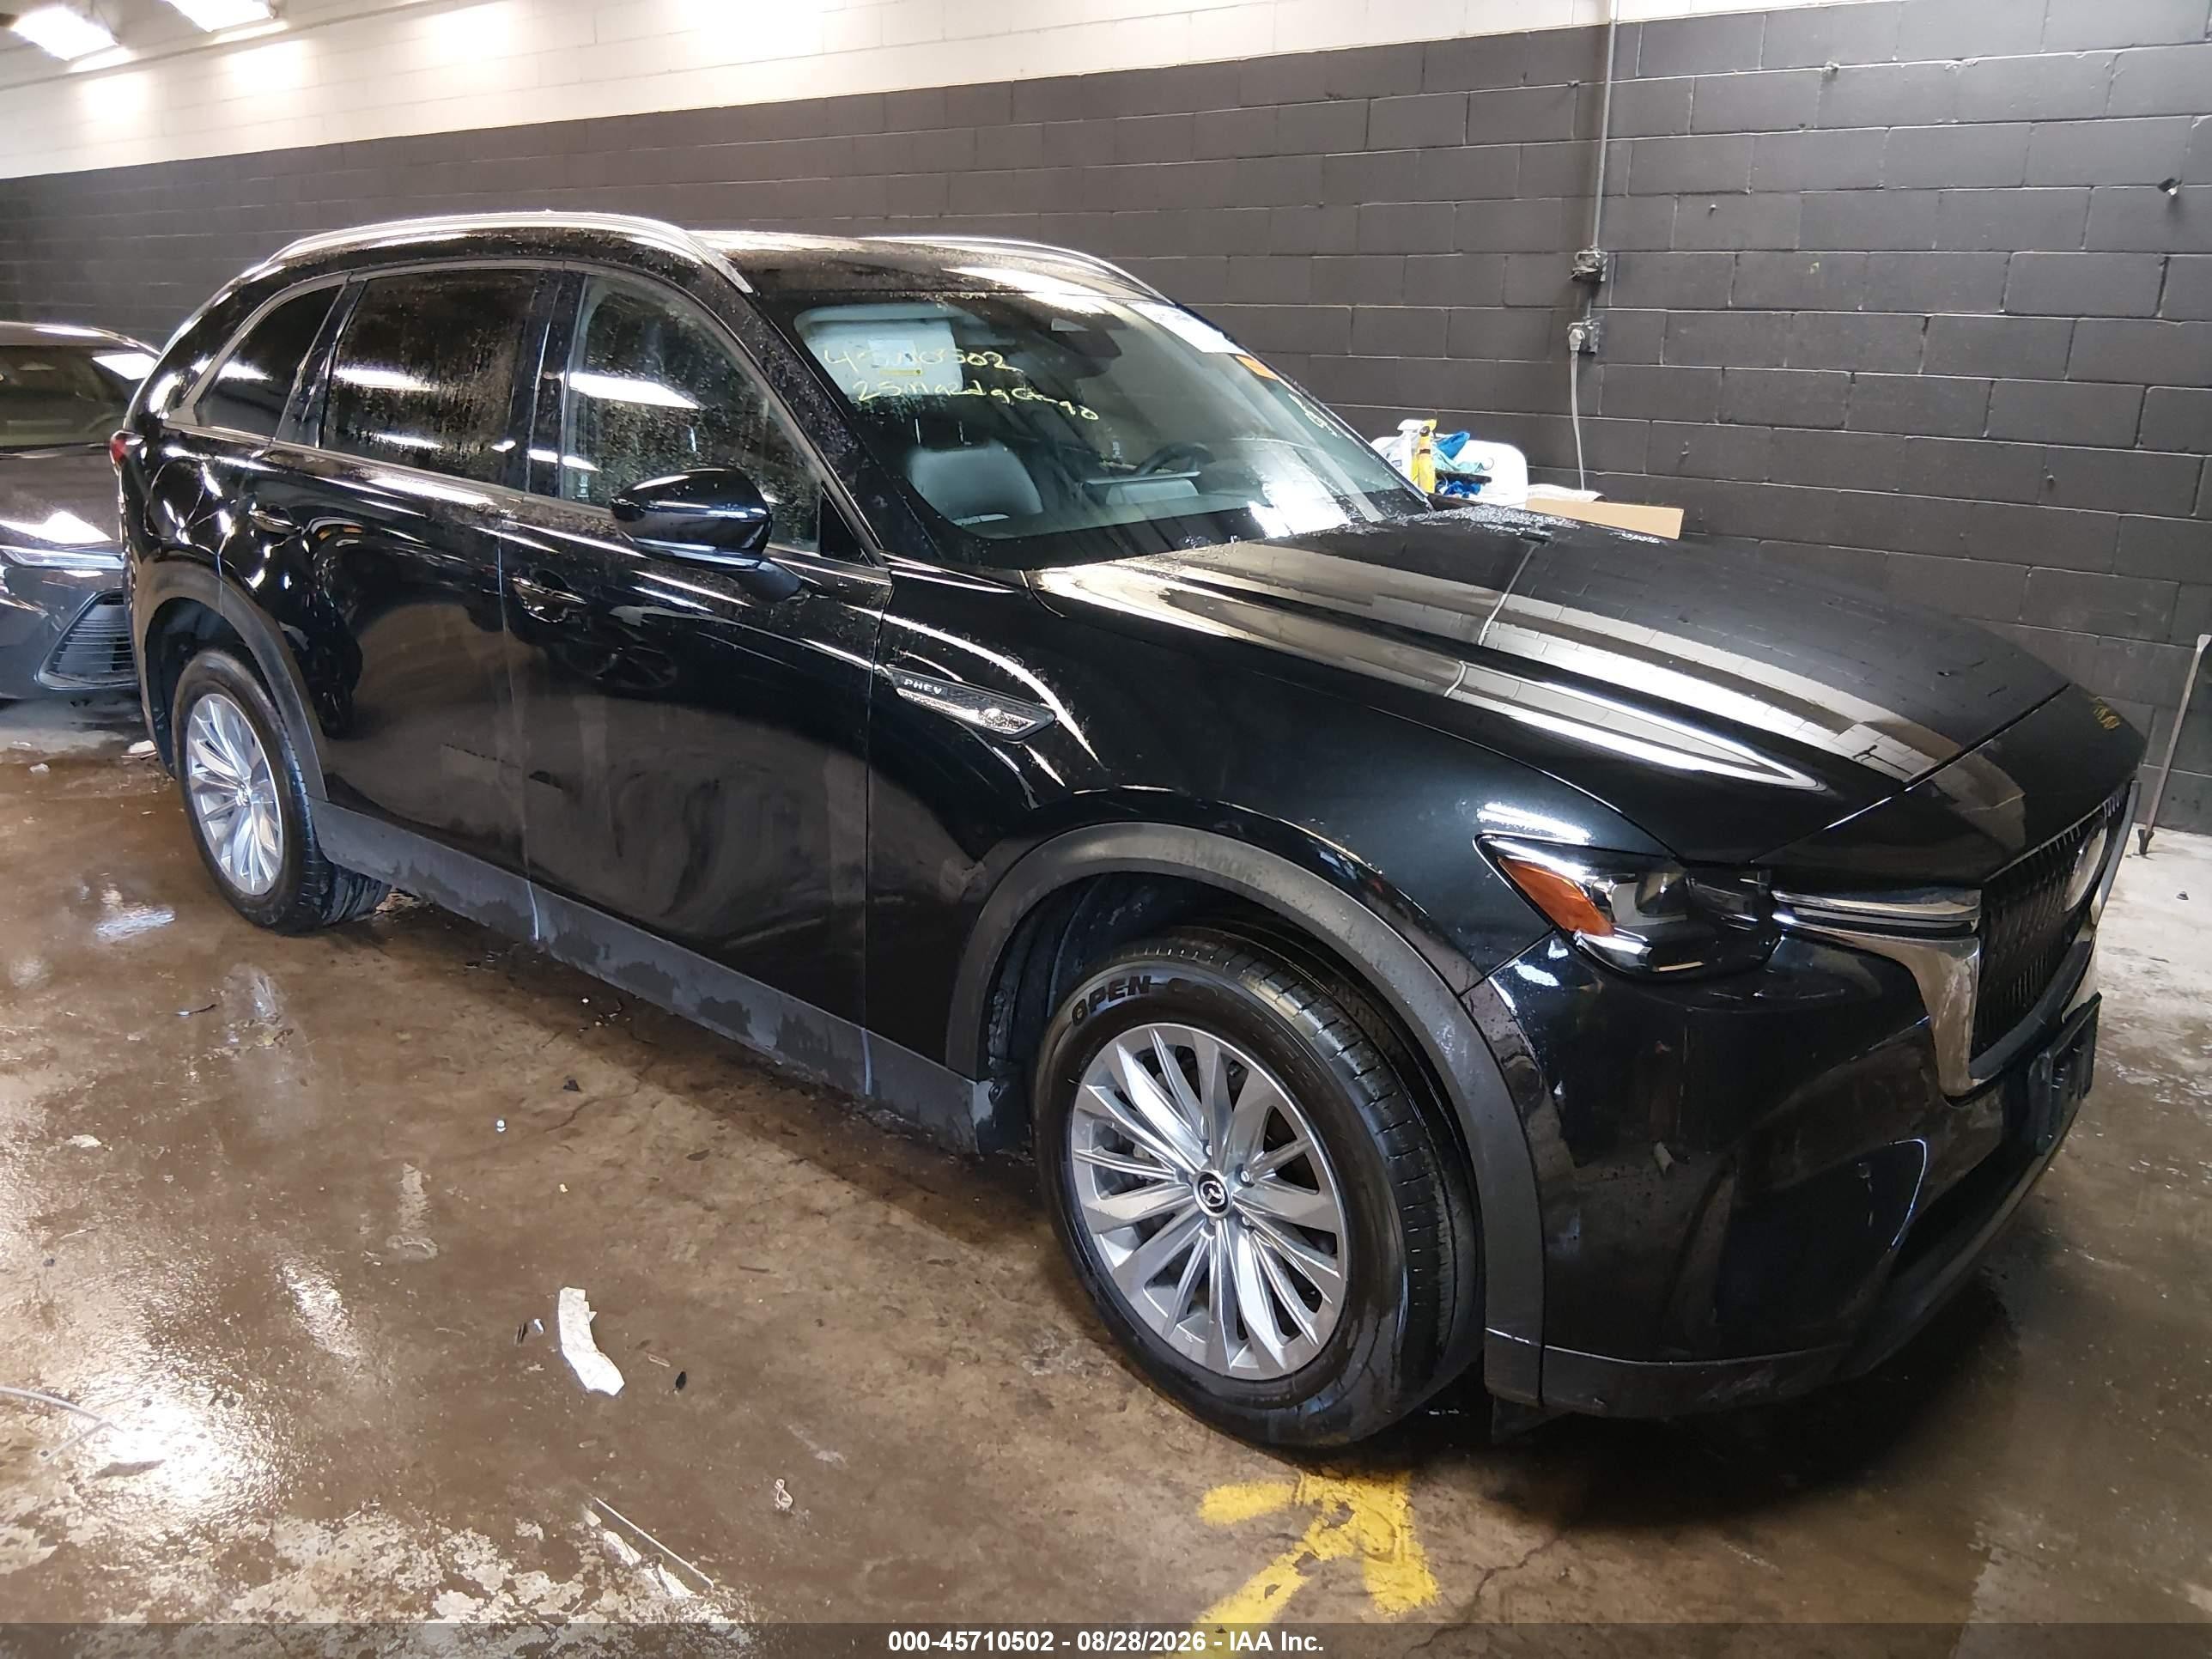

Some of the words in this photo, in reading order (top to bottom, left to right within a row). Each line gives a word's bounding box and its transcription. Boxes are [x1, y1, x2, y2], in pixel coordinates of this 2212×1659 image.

[823, 346, 1024, 372] 40502
[903, 678, 943, 695] PHEV
[1072, 975, 1152, 1025] OPEN
